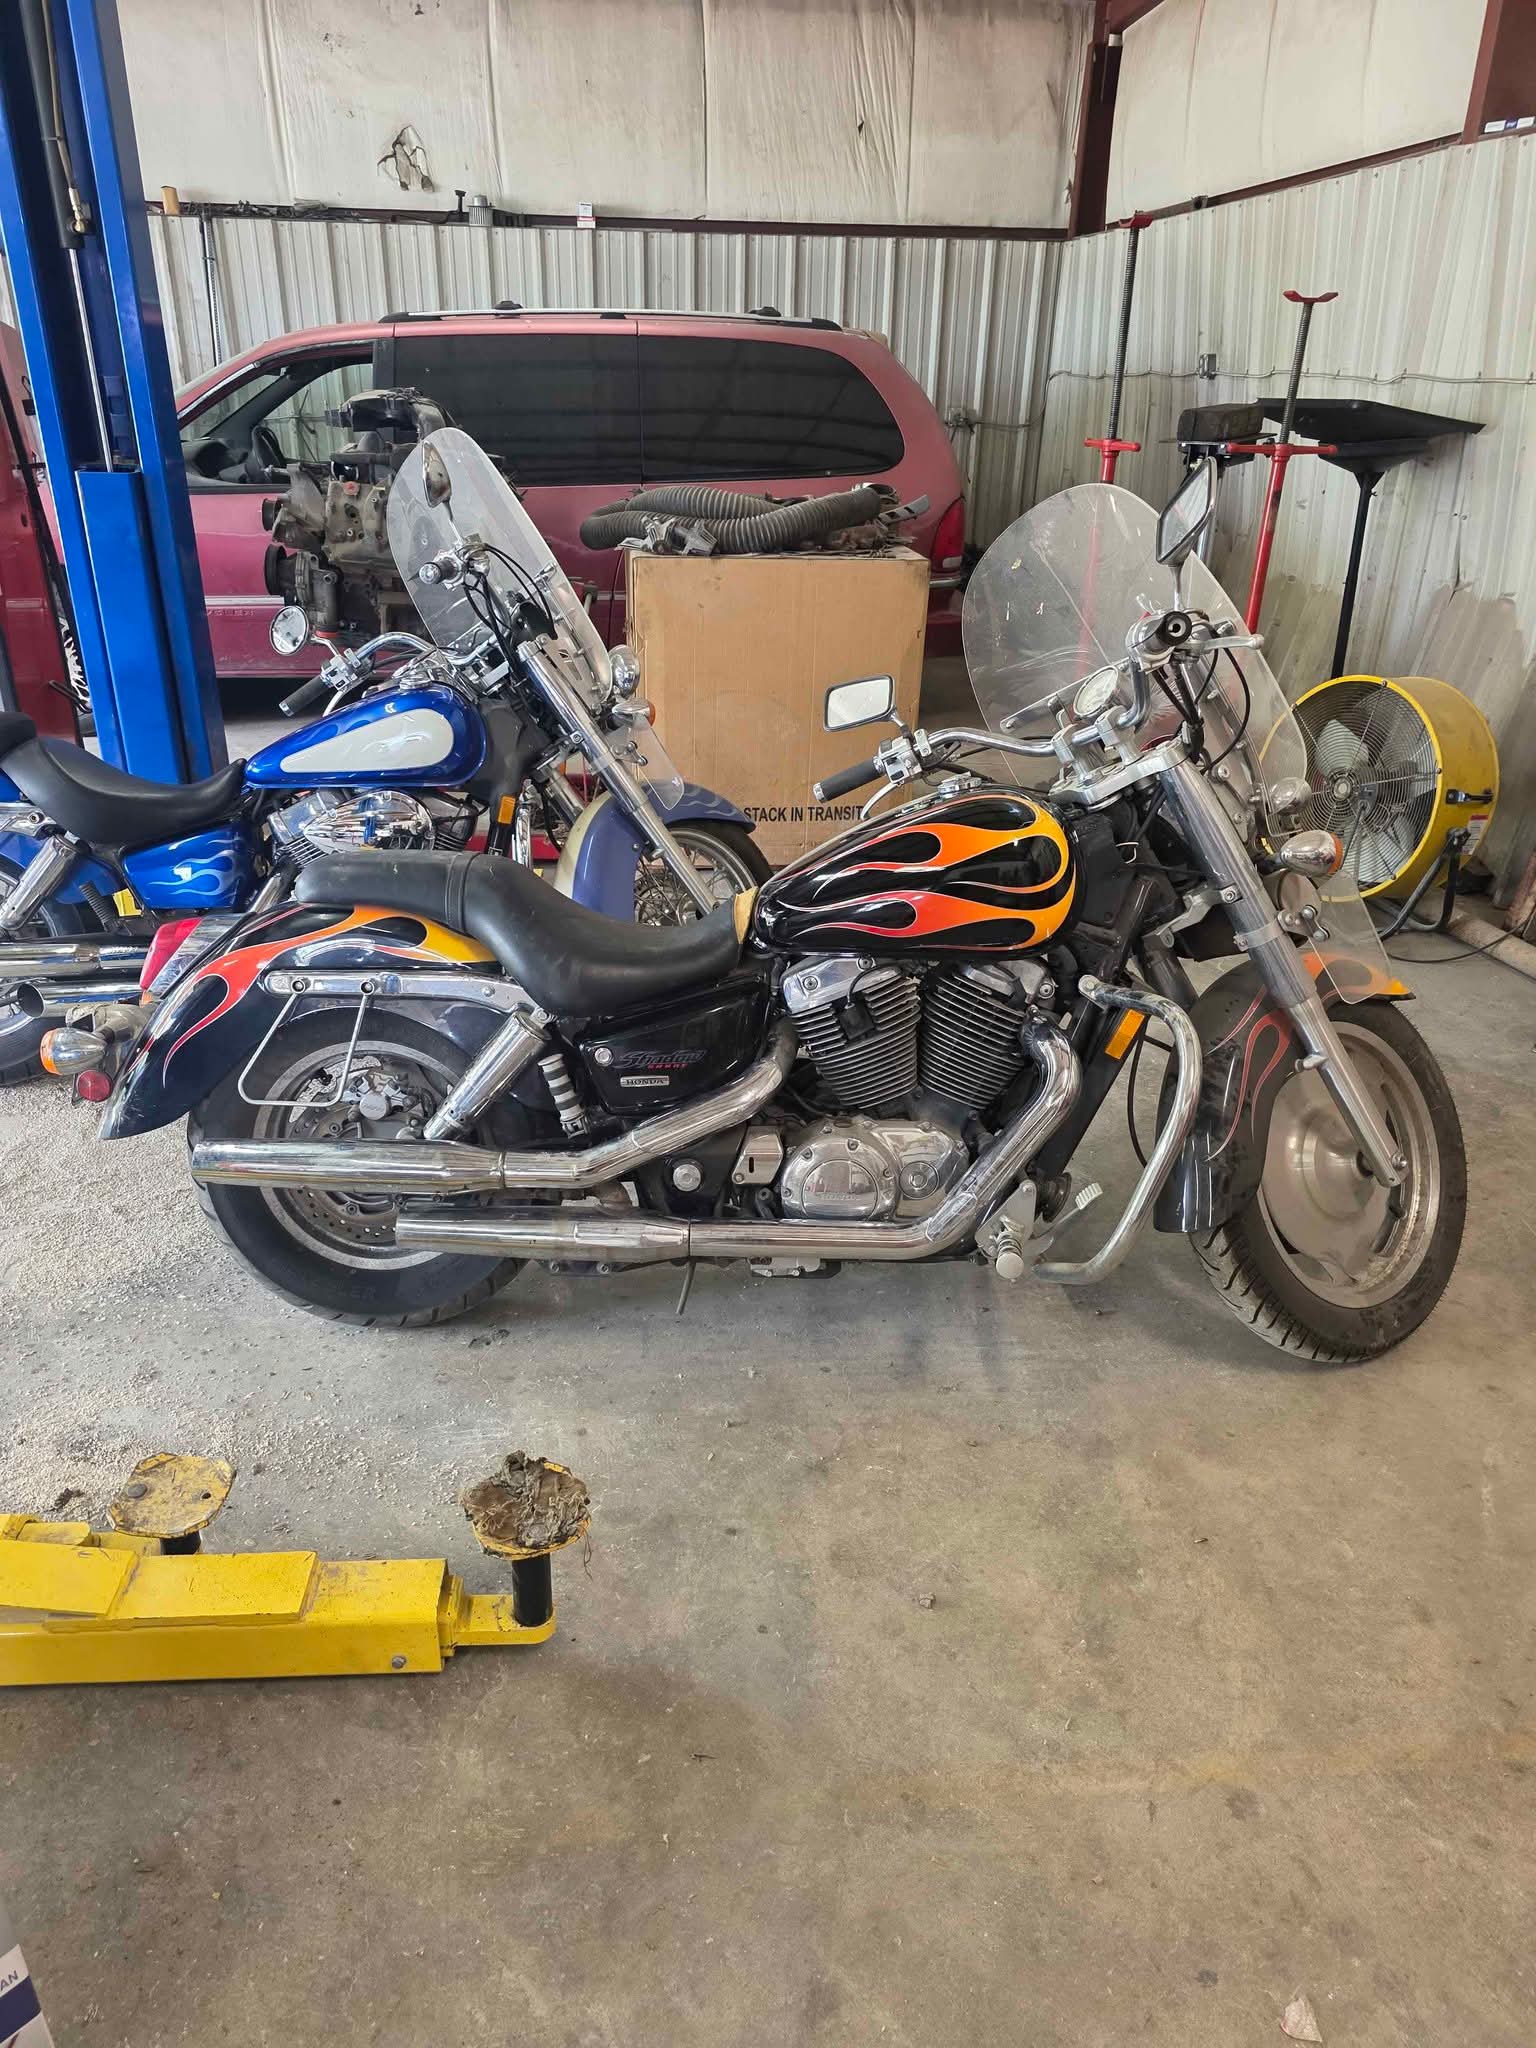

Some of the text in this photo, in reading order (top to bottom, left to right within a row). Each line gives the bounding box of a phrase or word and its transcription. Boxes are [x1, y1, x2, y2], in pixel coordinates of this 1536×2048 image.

[743, 805, 864, 822] STACK IN TRANSIT
[624, 1078, 665, 1087] HONDA
